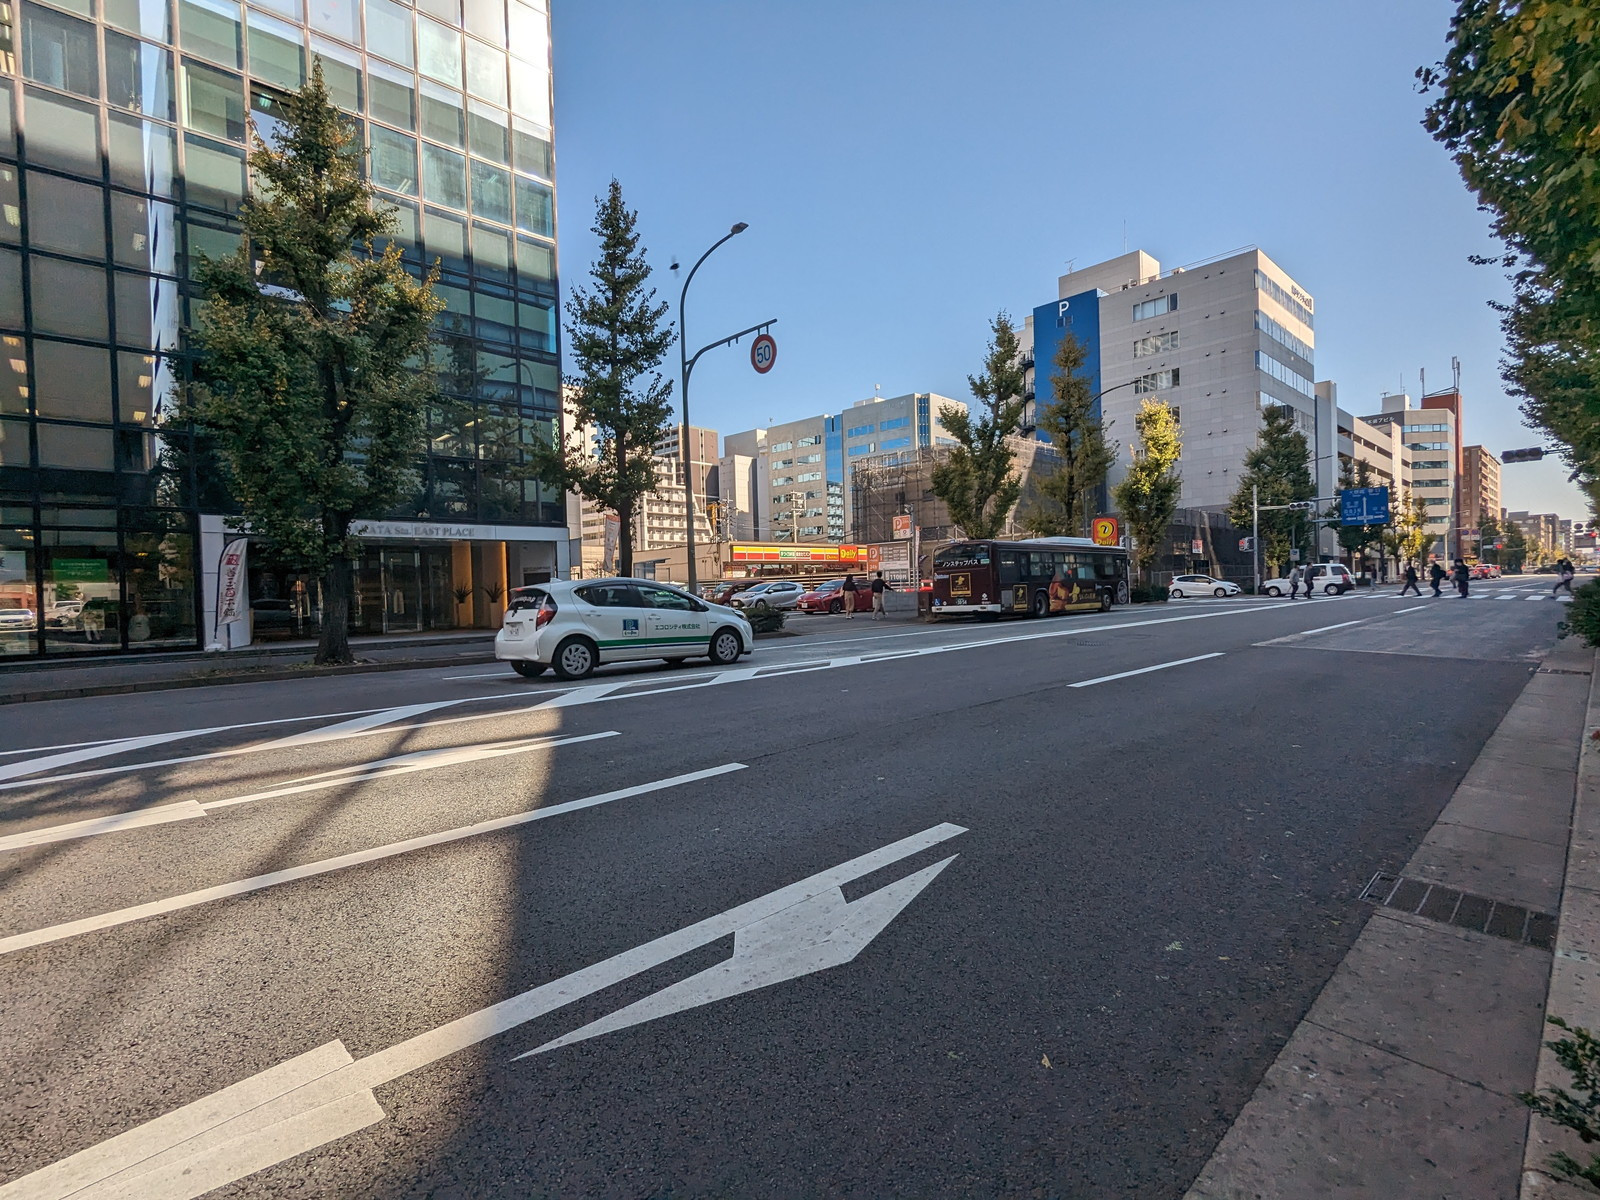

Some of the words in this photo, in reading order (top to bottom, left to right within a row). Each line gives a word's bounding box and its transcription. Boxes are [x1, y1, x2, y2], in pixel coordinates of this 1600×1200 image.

[1058, 300, 1070, 317] P
[756, 344, 771, 364] 50
[414, 526, 441, 537] EAST
[443, 527, 475, 538] PLACE
[840, 549, 857, 559] Daily
[942, 559, 979, 567] ノンステップバス
